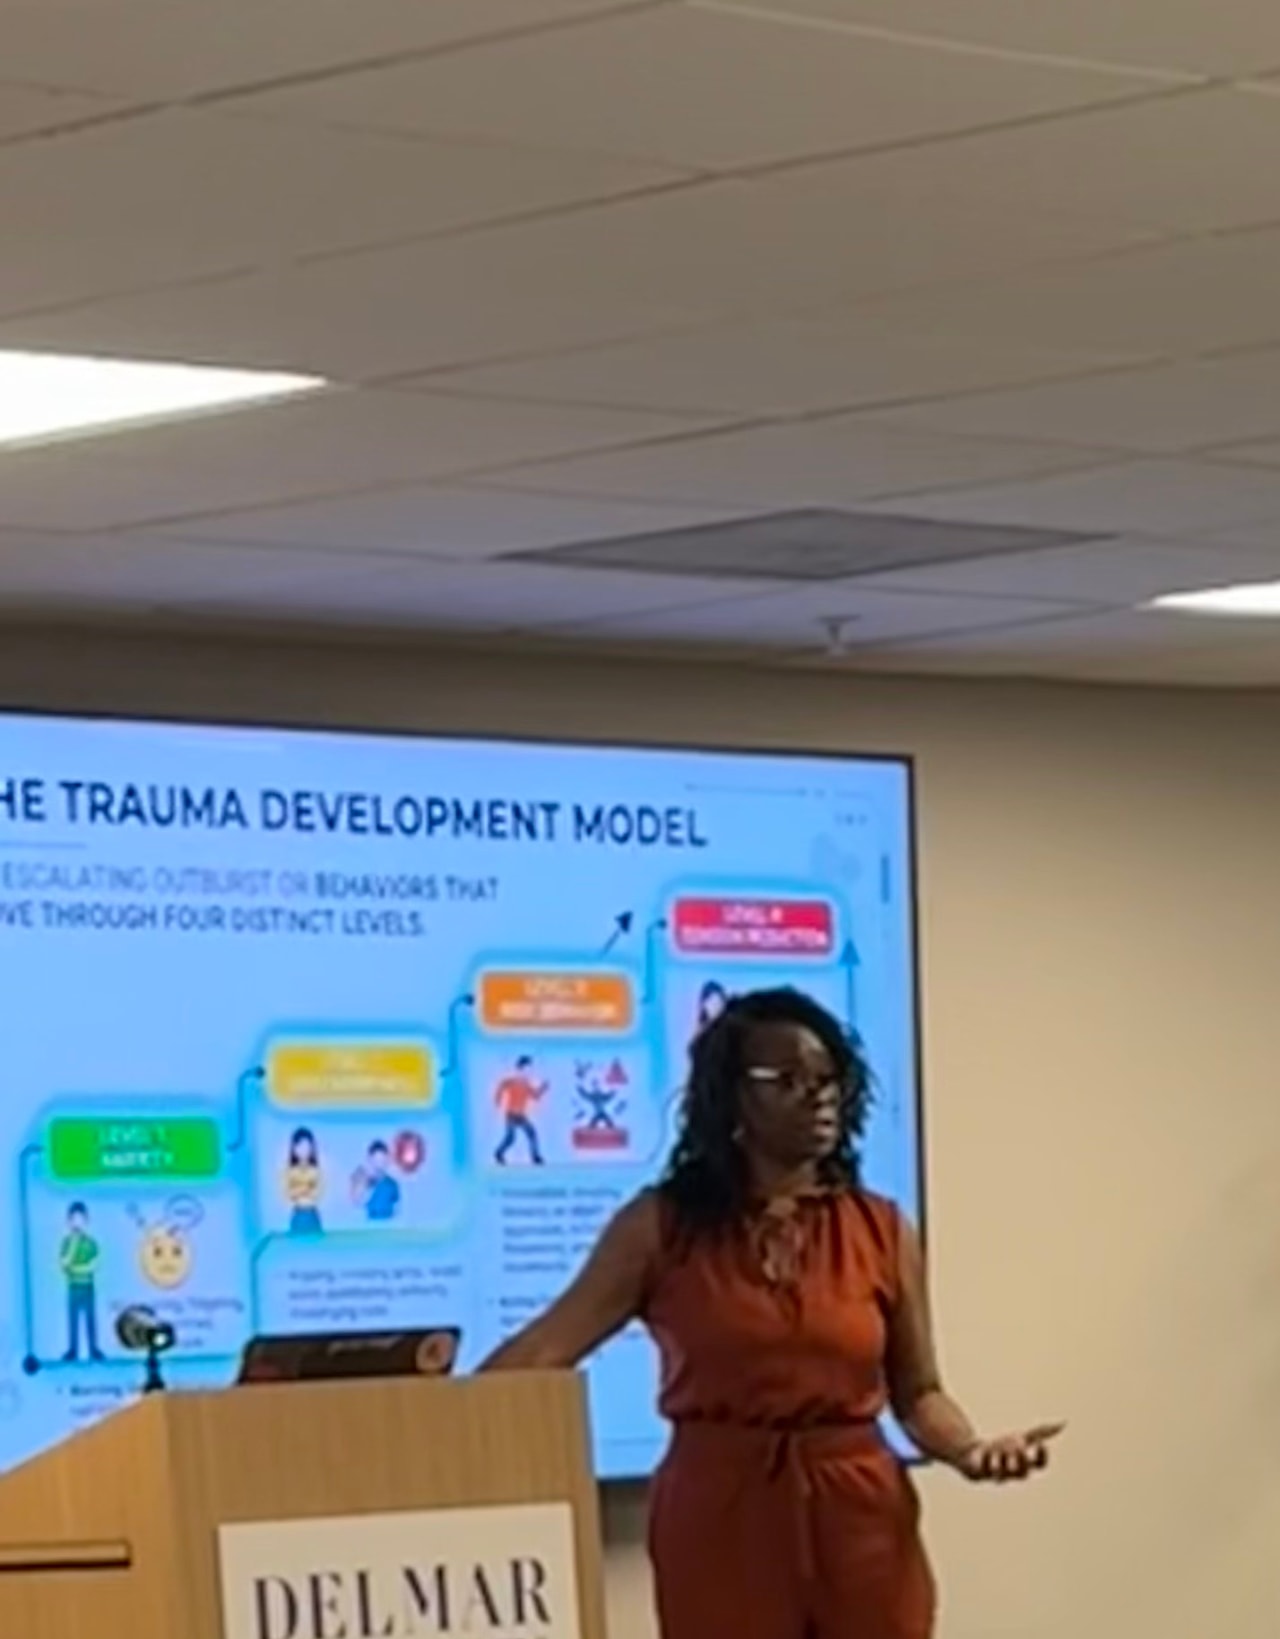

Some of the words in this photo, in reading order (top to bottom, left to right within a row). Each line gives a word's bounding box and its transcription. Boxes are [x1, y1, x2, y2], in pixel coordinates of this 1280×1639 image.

[58, 780, 249, 830] TRAUMA
[259, 788, 561, 842] DEVELOPMENT
[572, 802, 709, 848] MODEL
[314, 869, 441, 902] BEHAVIORS
[445, 873, 500, 903] THAT
[41, 900, 158, 931] THROUGH
[162, 903, 227, 933] FOUR
[231, 905, 337, 935] DISTINCT
